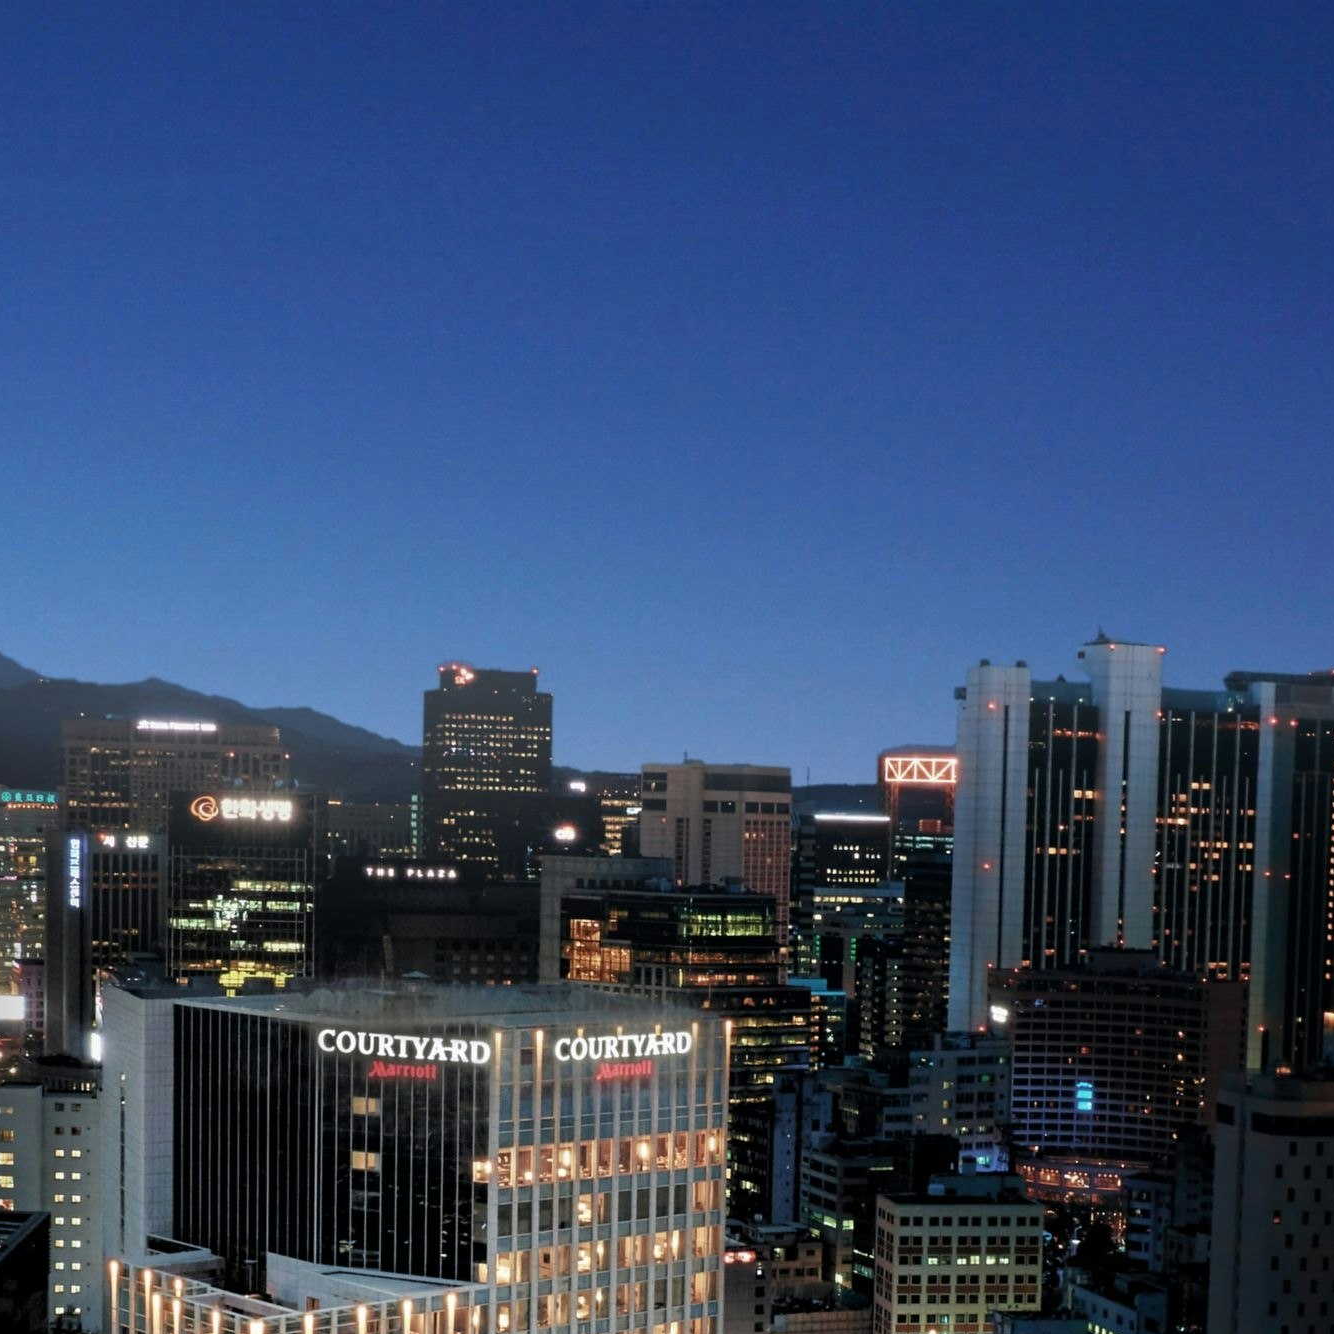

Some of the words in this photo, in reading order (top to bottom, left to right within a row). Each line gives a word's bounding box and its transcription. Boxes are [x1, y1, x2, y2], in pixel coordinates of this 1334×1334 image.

[366, 867, 395, 878] THE
[407, 868, 457, 879] PLAZA
[317, 1028, 492, 1065] COURTYARD
[554, 1031, 693, 1062] COURTYARD
[368, 1060, 438, 1081] Marriott
[596, 1059, 652, 1081] Marriott
